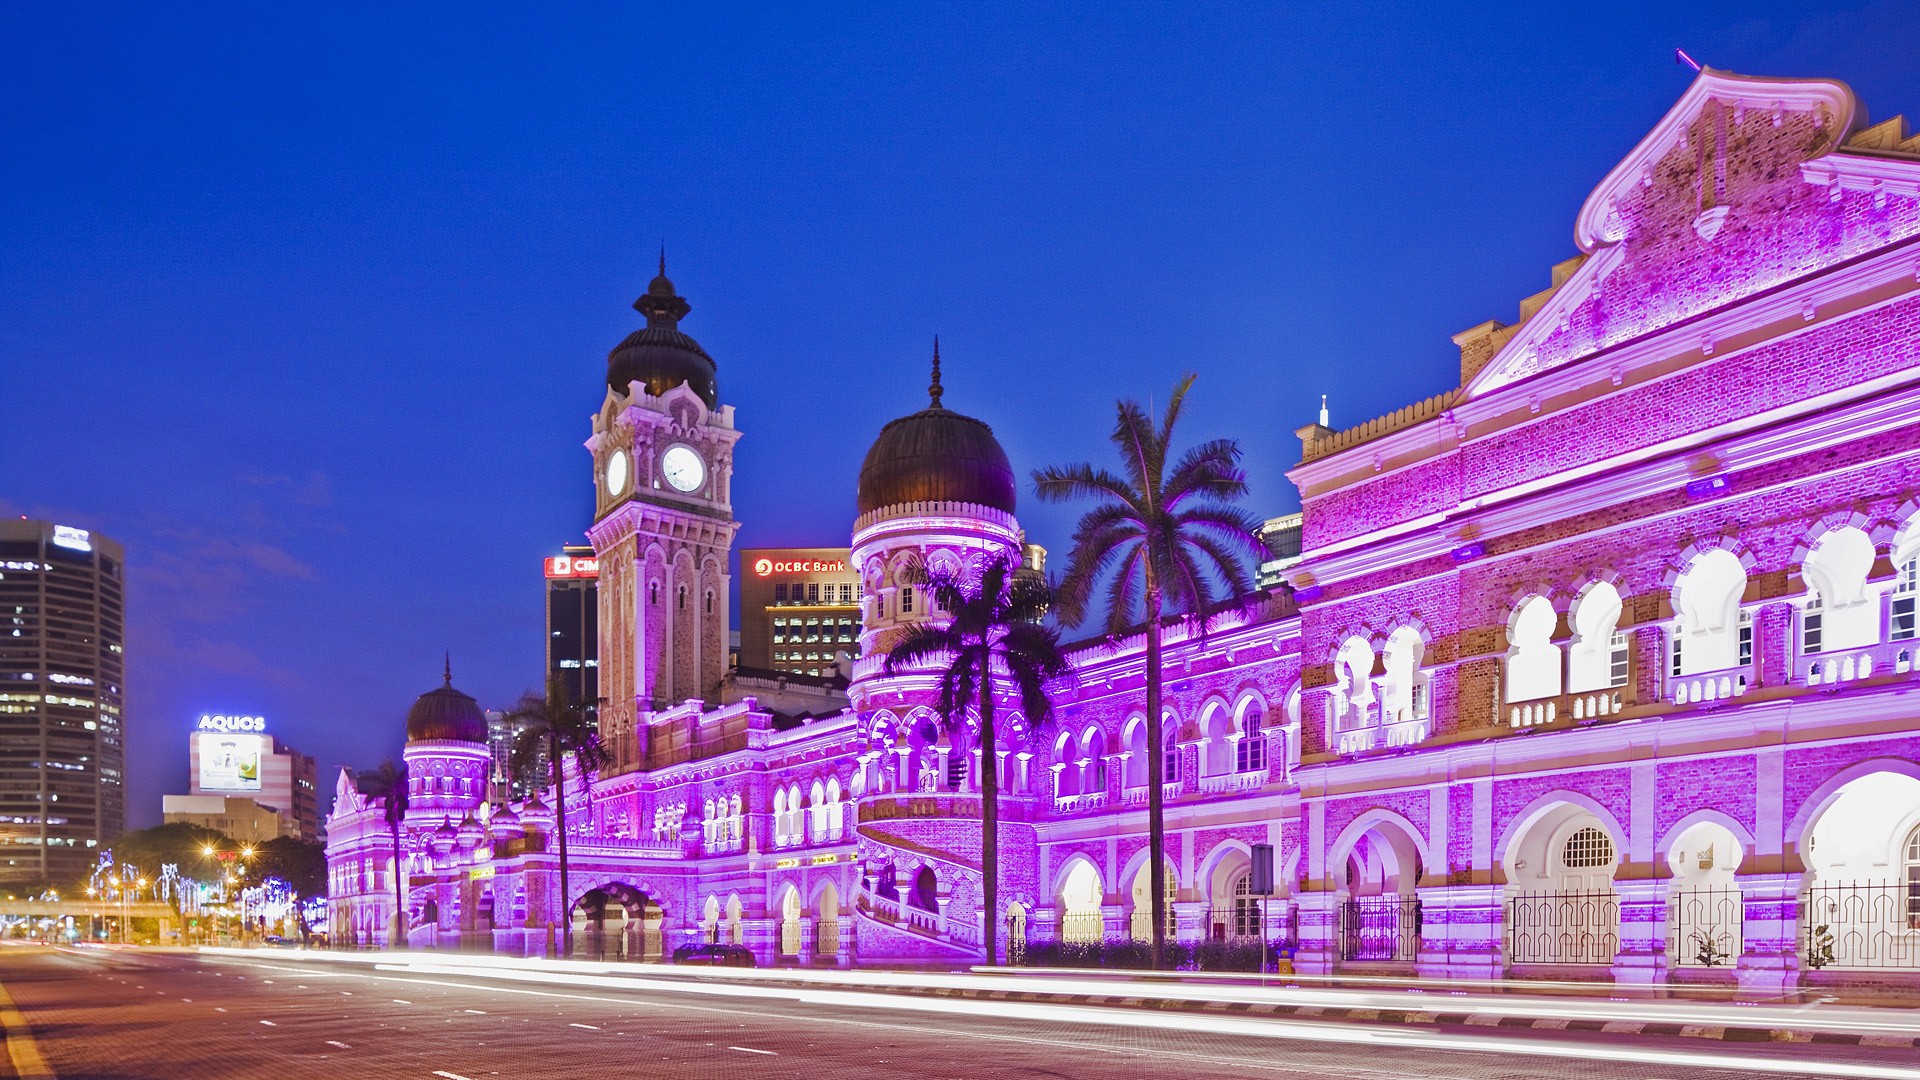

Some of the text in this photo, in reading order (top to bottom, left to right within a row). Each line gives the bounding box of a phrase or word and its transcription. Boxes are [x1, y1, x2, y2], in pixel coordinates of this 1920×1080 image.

[775, 561, 844, 572] OCBC Bank
[198, 715, 265, 732] AQUOS
